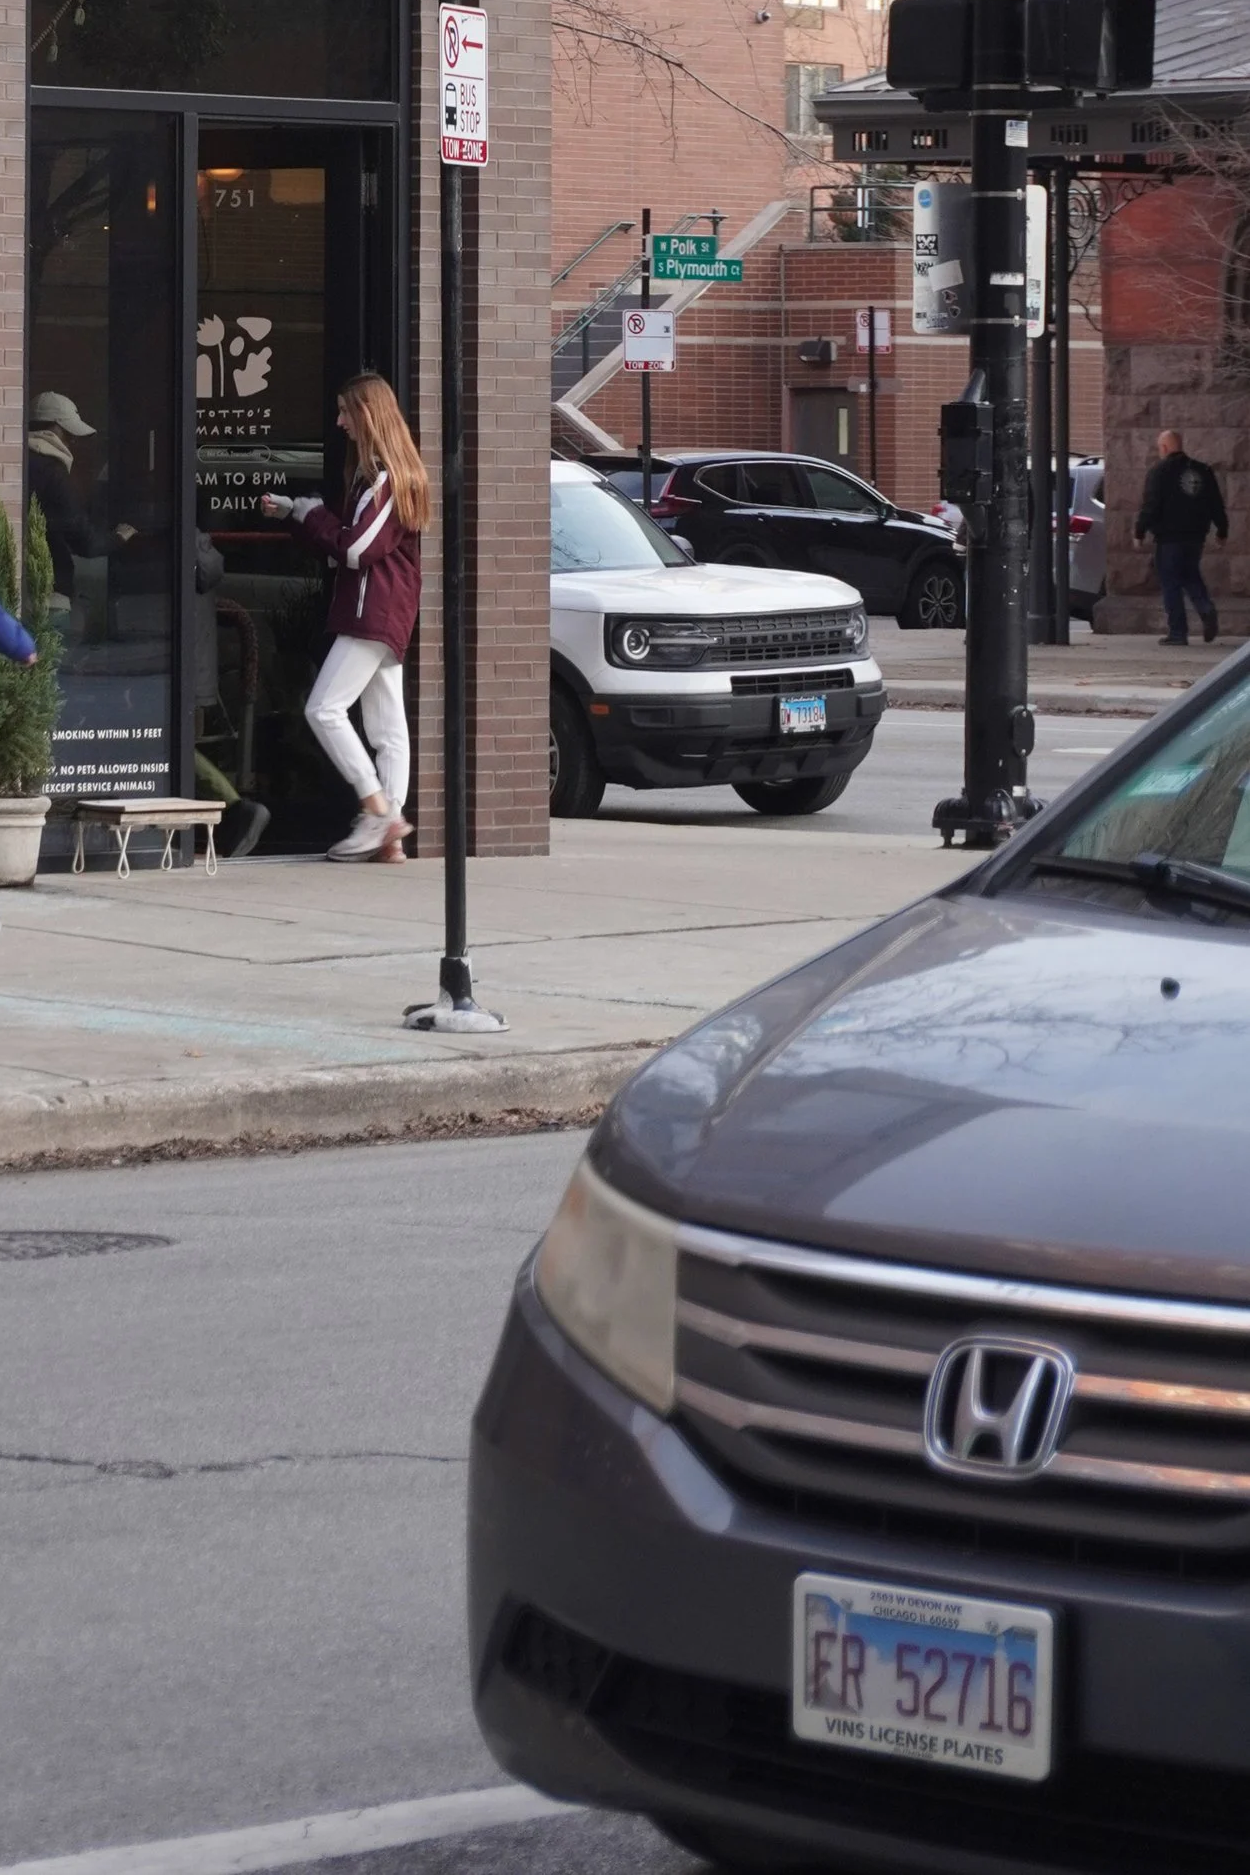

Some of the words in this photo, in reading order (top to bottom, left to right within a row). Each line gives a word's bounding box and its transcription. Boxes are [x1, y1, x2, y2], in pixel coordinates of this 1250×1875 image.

[460, 83, 477, 107] BUS
[460, 110, 481, 134] STOP
[444, 138, 460, 158] TOW
[462, 140, 484, 161] ZONE
[215, 189, 254, 208] 751
[659, 242, 667, 252] W
[670, 238, 697, 255] Polk
[700, 242, 710, 252] St
[658, 262, 664, 272] S
[666, 259, 727, 278] Plymouth
[730, 265, 740, 276] Ct
[627, 361, 645, 369] TOW
[196, 408, 271, 419] TOTTO'S
[196, 424, 271, 436] MARKET
[196, 471, 218, 486] AM
[224, 471, 246, 486] TO
[252, 471, 287, 486] 8PM
[210, 496, 259, 510] DAILY
[729, 629, 842, 644] BRONCO
[796, 705, 825, 724] 73184
[52, 728, 95, 740] SMOKING
[97, 728, 129, 739] WITHIN
[132, 728, 141, 739] 15
[143, 727, 163, 738] FEET
[60, 764, 75, 776] NO
[77, 764, 96, 775] PETS
[98, 763, 139, 775] ALLOWED
[140, 762, 170, 774] INSIDE
[42, 782, 75, 794] (EXCEPT
[77, 782, 112, 793] SERVICE
[113, 780, 156, 792] ANIMALS)
[895, 1595, 906, 1606] W
[907, 1596, 943, 1611] DEVON
[945, 1603, 963, 1615] AVE
[872, 1605, 917, 1622] CHICAGO
[919, 1612, 927, 1623] IL
[929, 1614, 960, 1630] 60659
[812, 1629, 865, 1714] FR
[896, 1641, 1033, 1739] 52716
[824, 1716, 865, 1739] VINS
[868, 1724, 939, 1754] LICENSE
[942, 1738, 1004, 1766] PLATES
